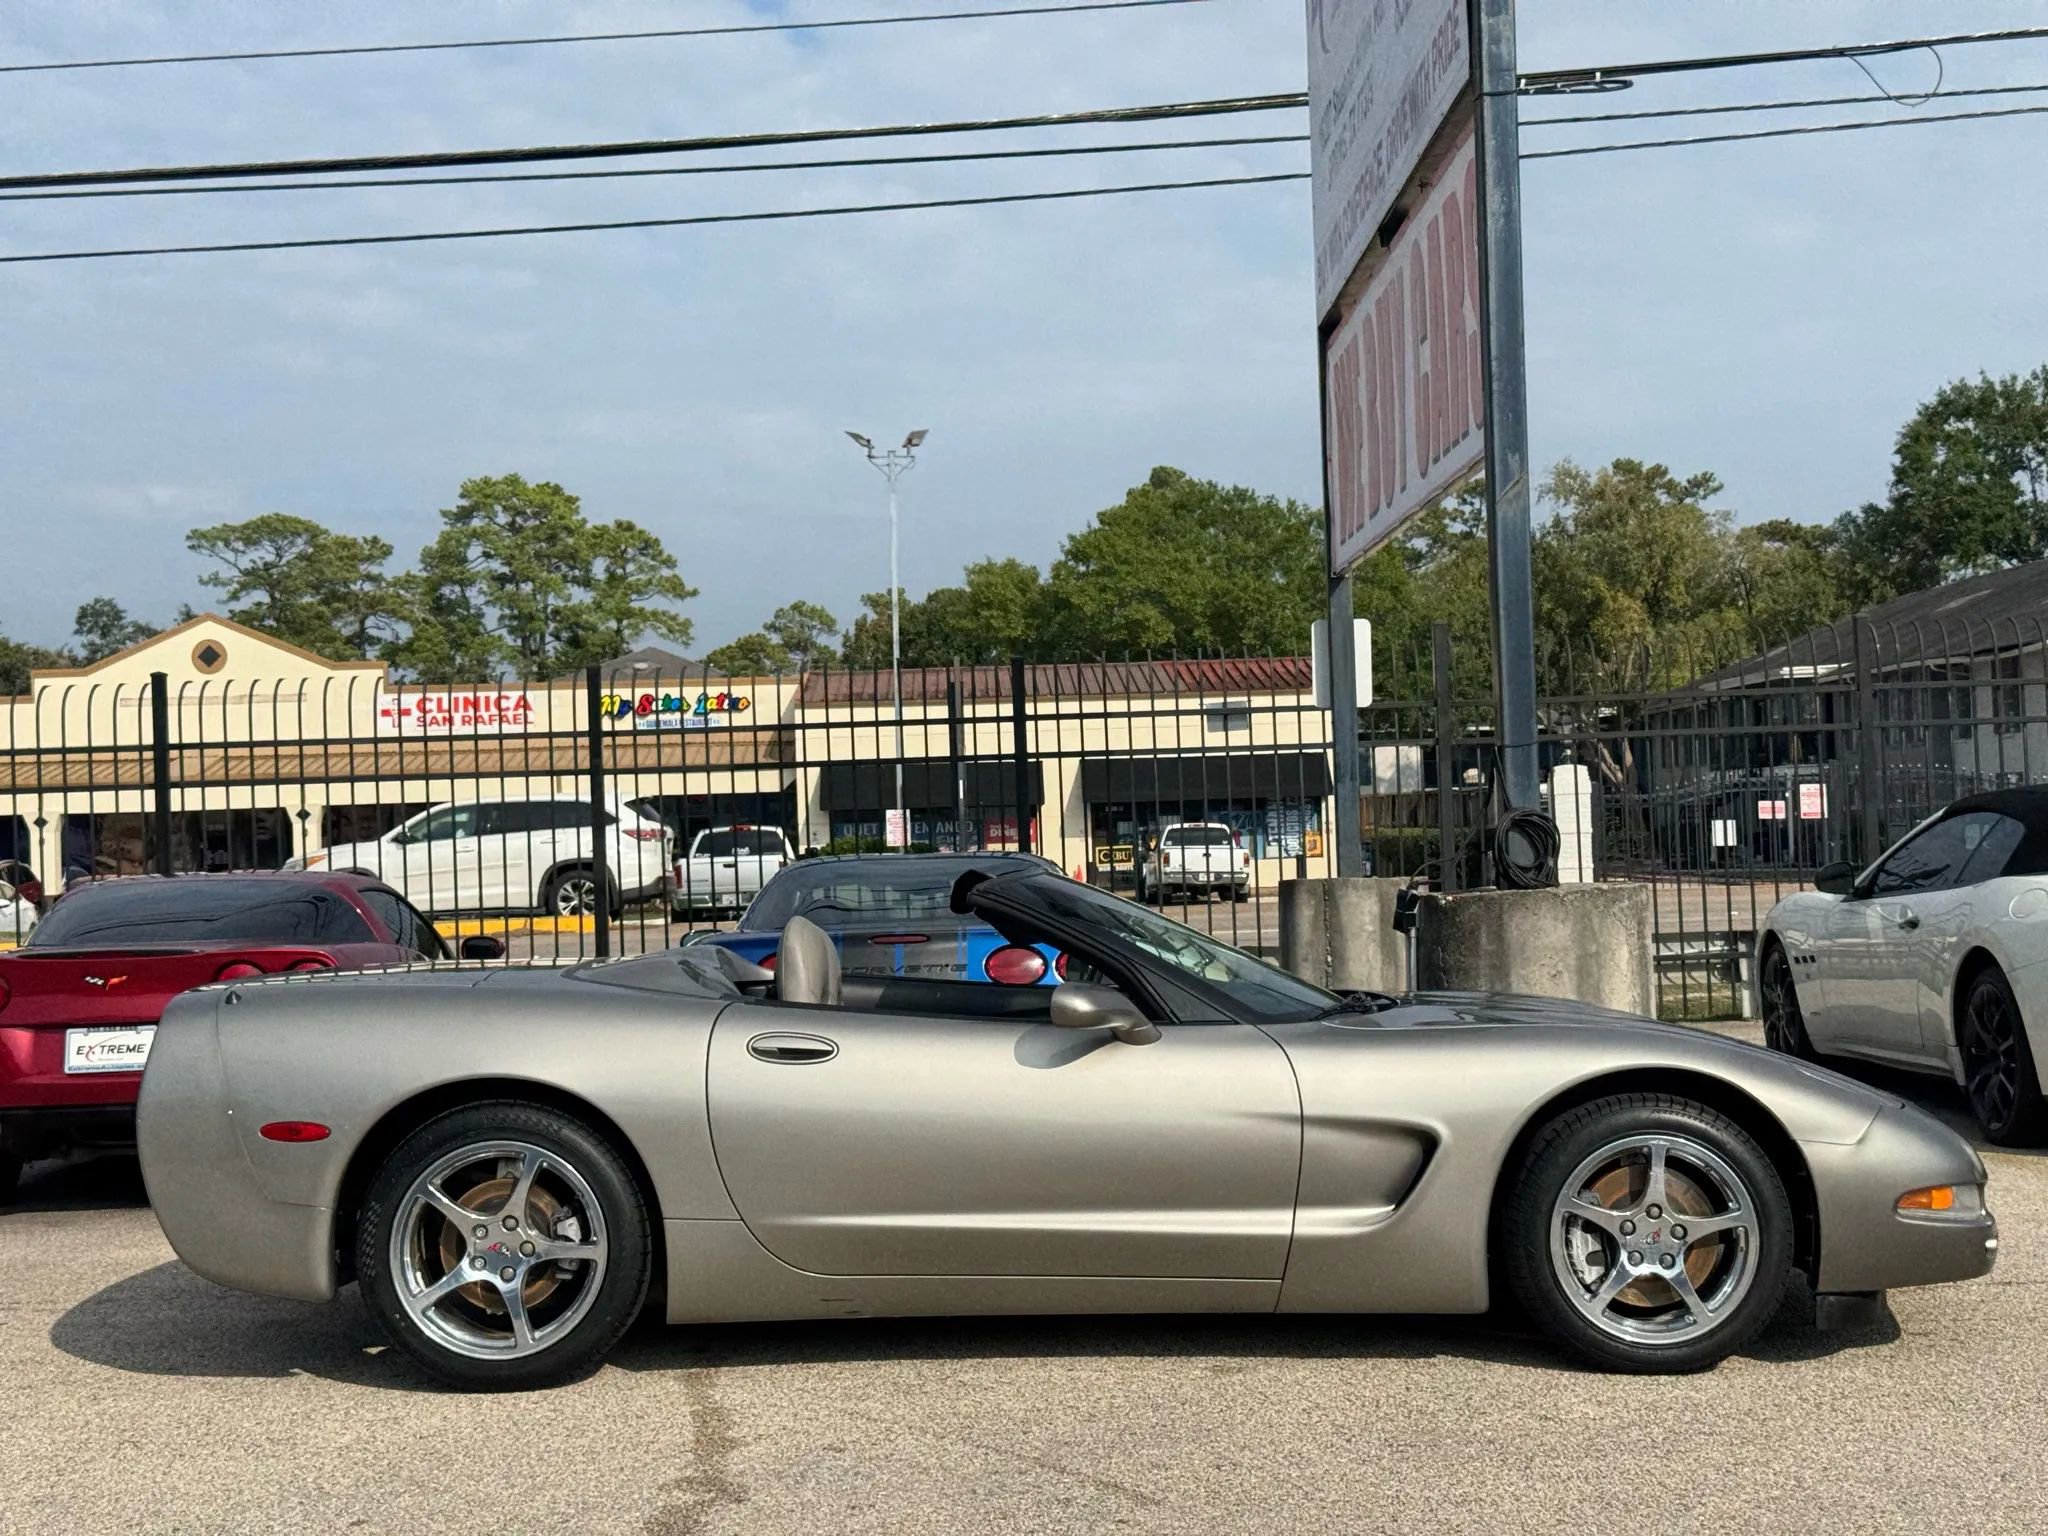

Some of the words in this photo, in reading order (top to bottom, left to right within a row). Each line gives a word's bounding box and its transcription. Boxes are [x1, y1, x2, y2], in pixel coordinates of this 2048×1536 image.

[1363, 264, 1408, 519] BUY
[1409, 157, 1484, 480] CARS
[415, 694, 534, 715] CLINICA
[416, 715, 455, 727] SAN
[461, 713, 535, 727] RAFAEL
[76, 1043, 147, 1056] EXTREME
